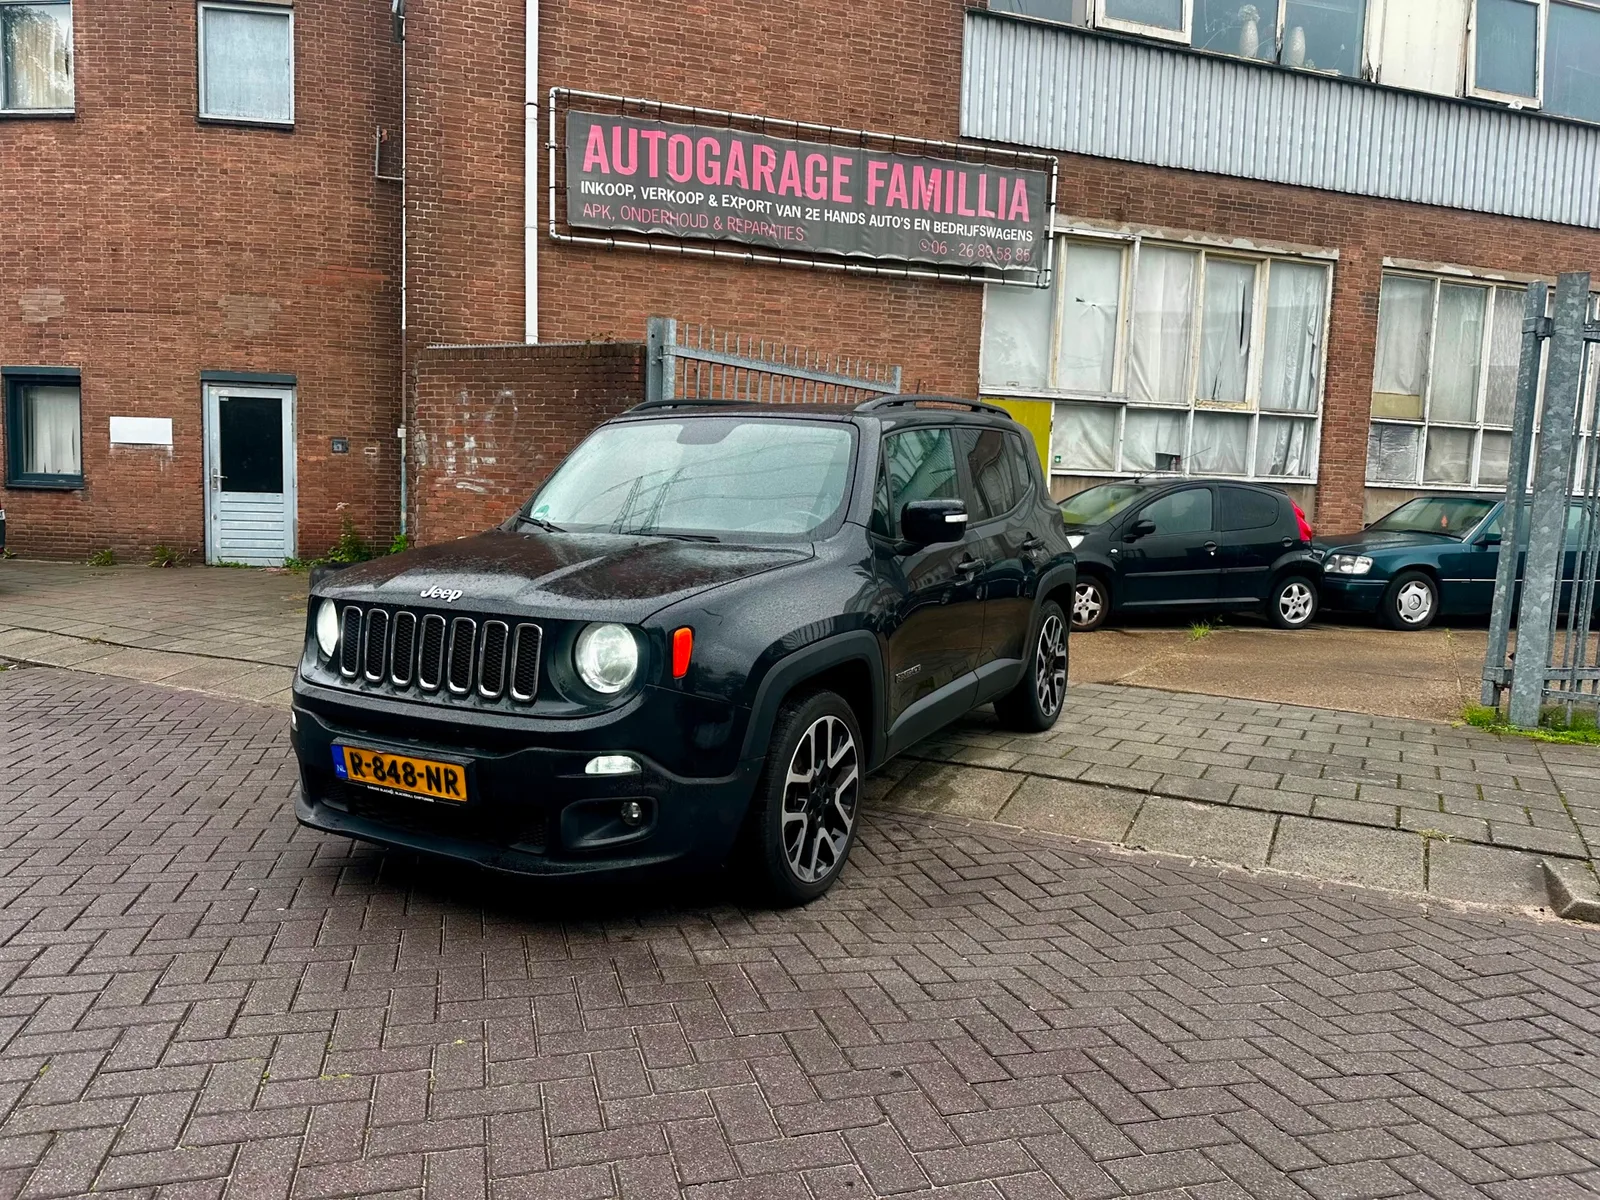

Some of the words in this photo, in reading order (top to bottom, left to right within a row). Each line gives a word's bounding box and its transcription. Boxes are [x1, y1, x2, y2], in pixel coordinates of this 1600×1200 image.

[582, 124, 853, 204] AUTOGARAGE
[867, 160, 1030, 223] FAMILLIA
[580, 180, 637, 200] INKOOP,
[640, 186, 704, 205] VERKOOP
[708, 194, 719, 207] &
[721, 194, 773, 214] EXPORT
[775, 203, 801, 219] VAN
[805, 207, 820, 221] 2E
[824, 209, 866, 225] HANDS
[868, 214, 911, 230] AUTO'S
[914, 218, 930, 232] EN
[933, 221, 1034, 242] BEDRIJFSWAGENS
[583, 202, 616, 222] APK,
[620, 205, 709, 229] ONDERHOUD
[713, 216, 723, 230] &
[727, 216, 804, 242] REPARATIES
[931, 240, 948, 254] 06
[958, 242, 974, 258] 26
[996, 247, 1012, 261] 58
[420, 585, 463, 603] Jeep
[349, 751, 461, 796] R-848-NR
